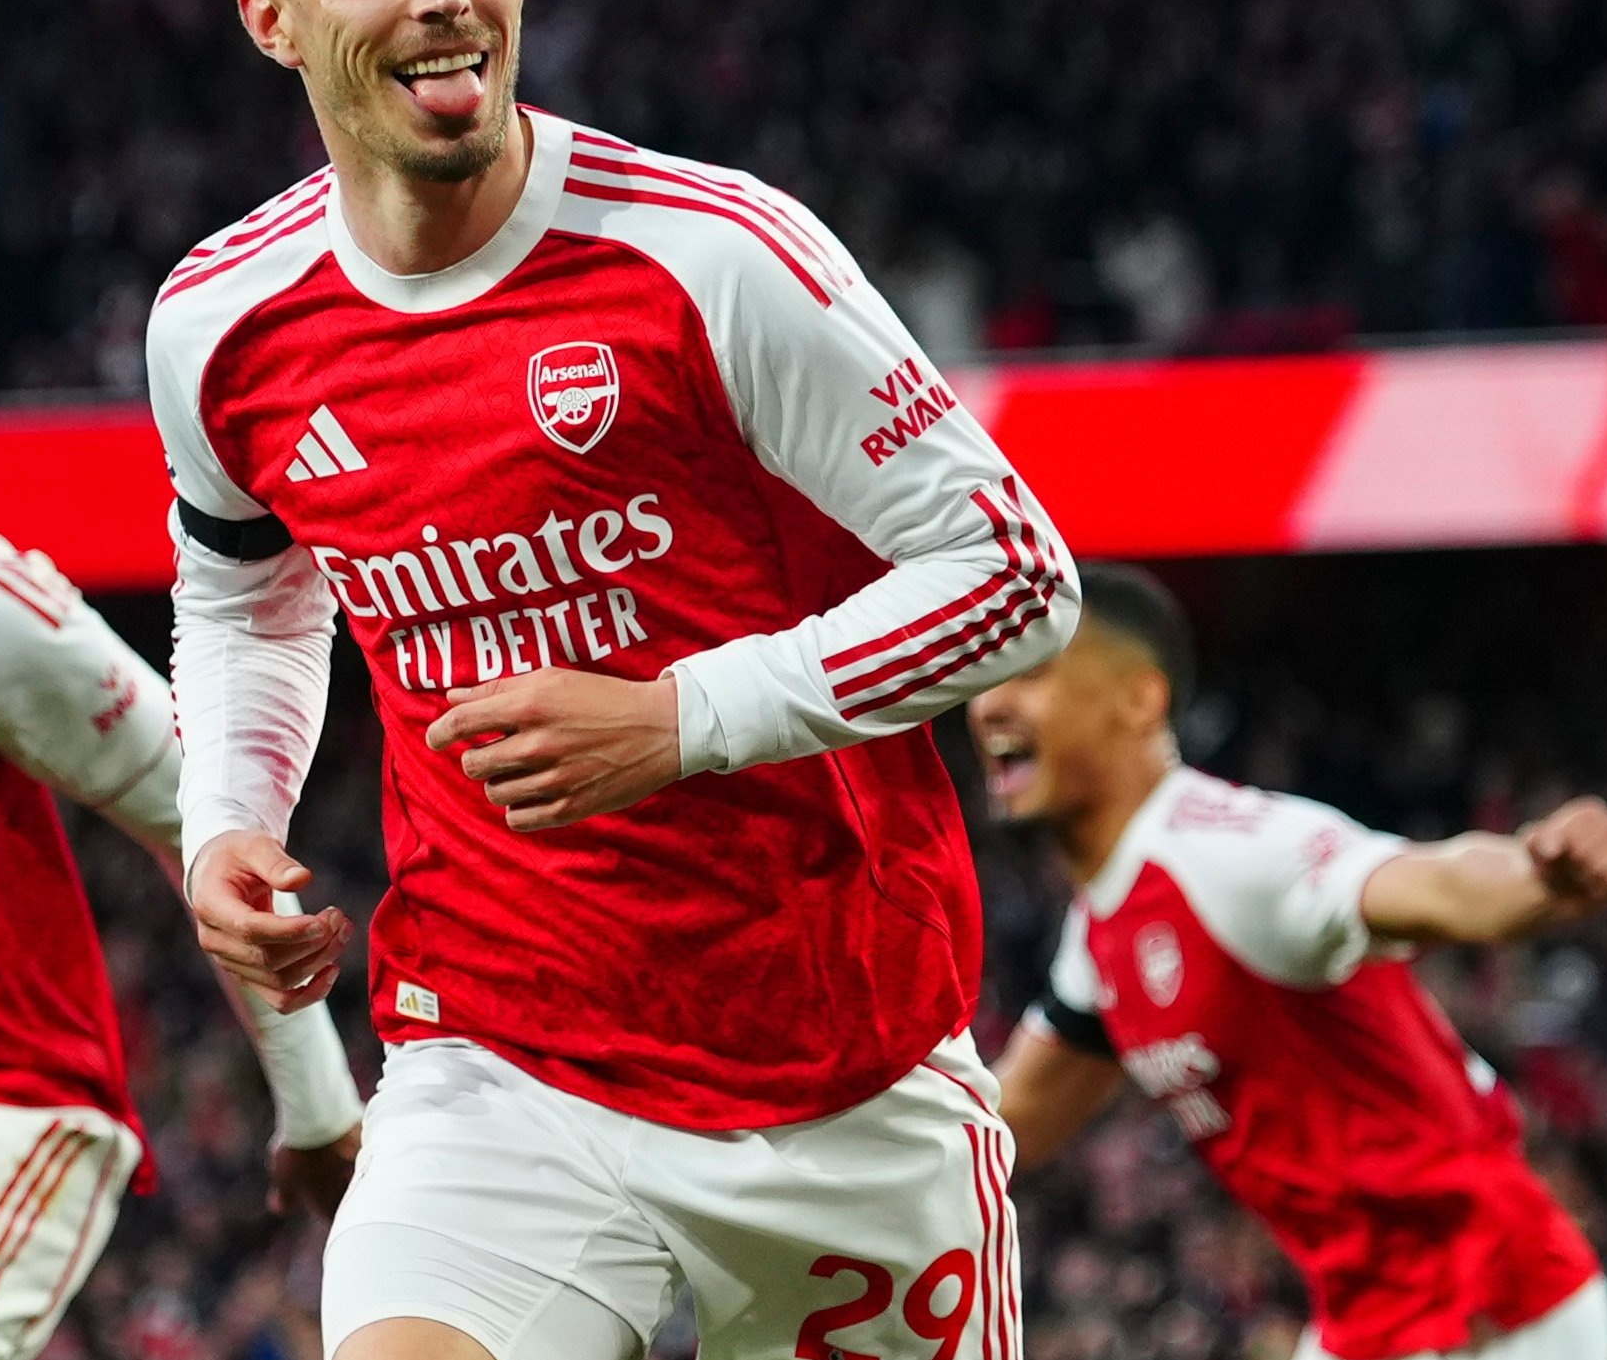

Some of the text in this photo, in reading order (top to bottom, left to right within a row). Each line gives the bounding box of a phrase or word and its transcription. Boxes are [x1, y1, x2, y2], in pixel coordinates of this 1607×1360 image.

[540, 359, 606, 384] Arsenal
[311, 493, 674, 619] Emirates
[389, 587, 648, 690] FLY BETTER
